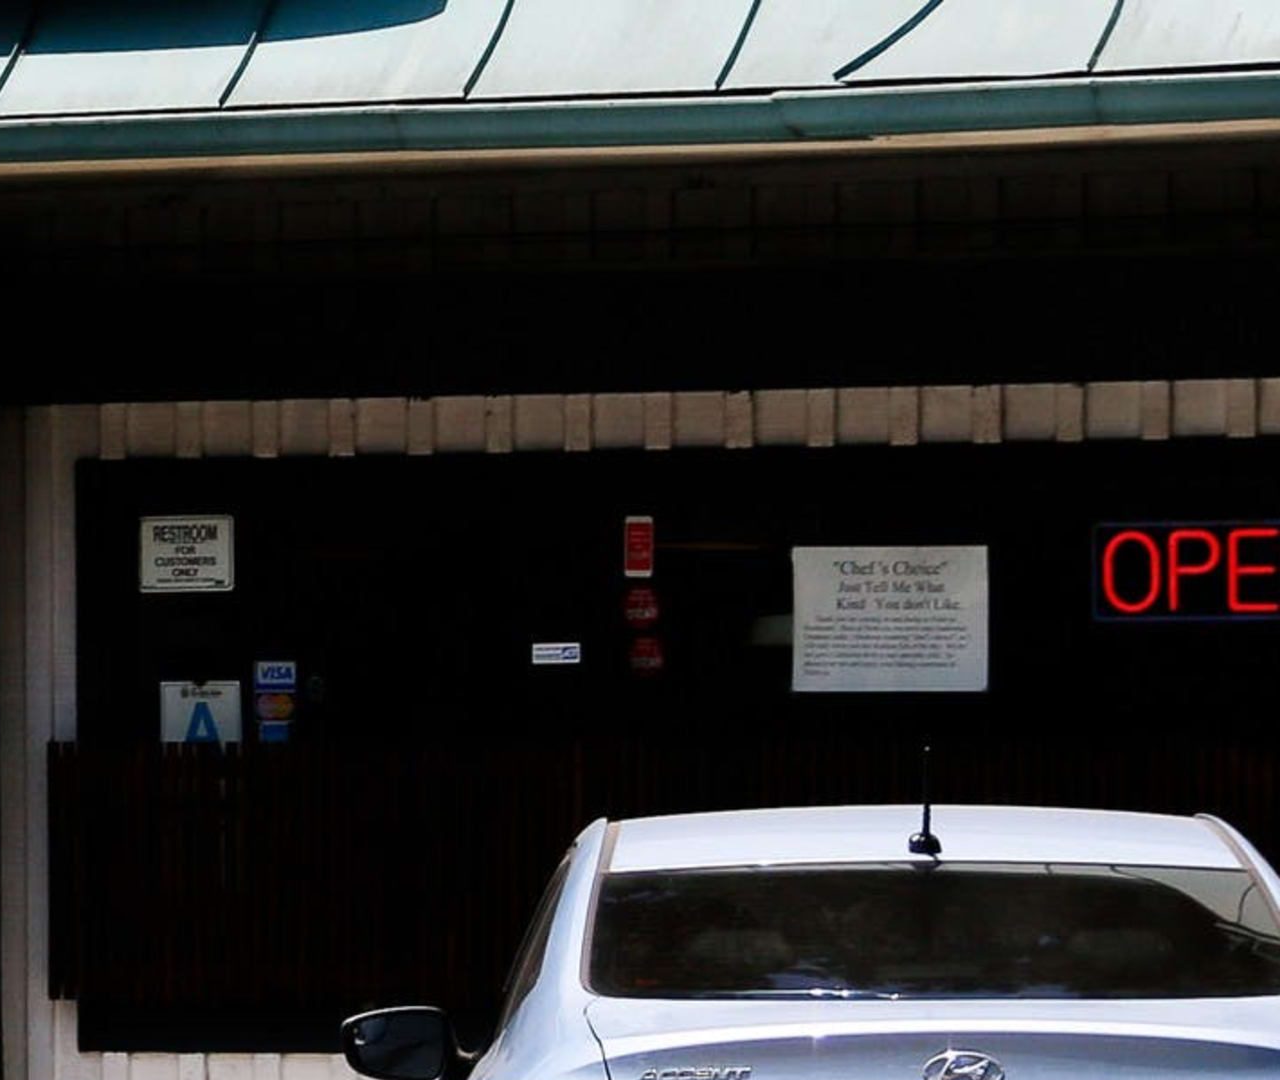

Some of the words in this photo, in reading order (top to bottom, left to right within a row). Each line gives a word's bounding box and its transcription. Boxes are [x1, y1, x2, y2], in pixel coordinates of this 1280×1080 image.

[153, 524, 218, 543] RESTROOM
[175, 546, 197, 555] FOR
[155, 556, 217, 567] CUSTOMERS
[171, 568, 199, 577] ONLY
[1101, 527, 1280, 613] OPE
[259, 666, 292, 680] VISA
[186, 701, 223, 747] A
